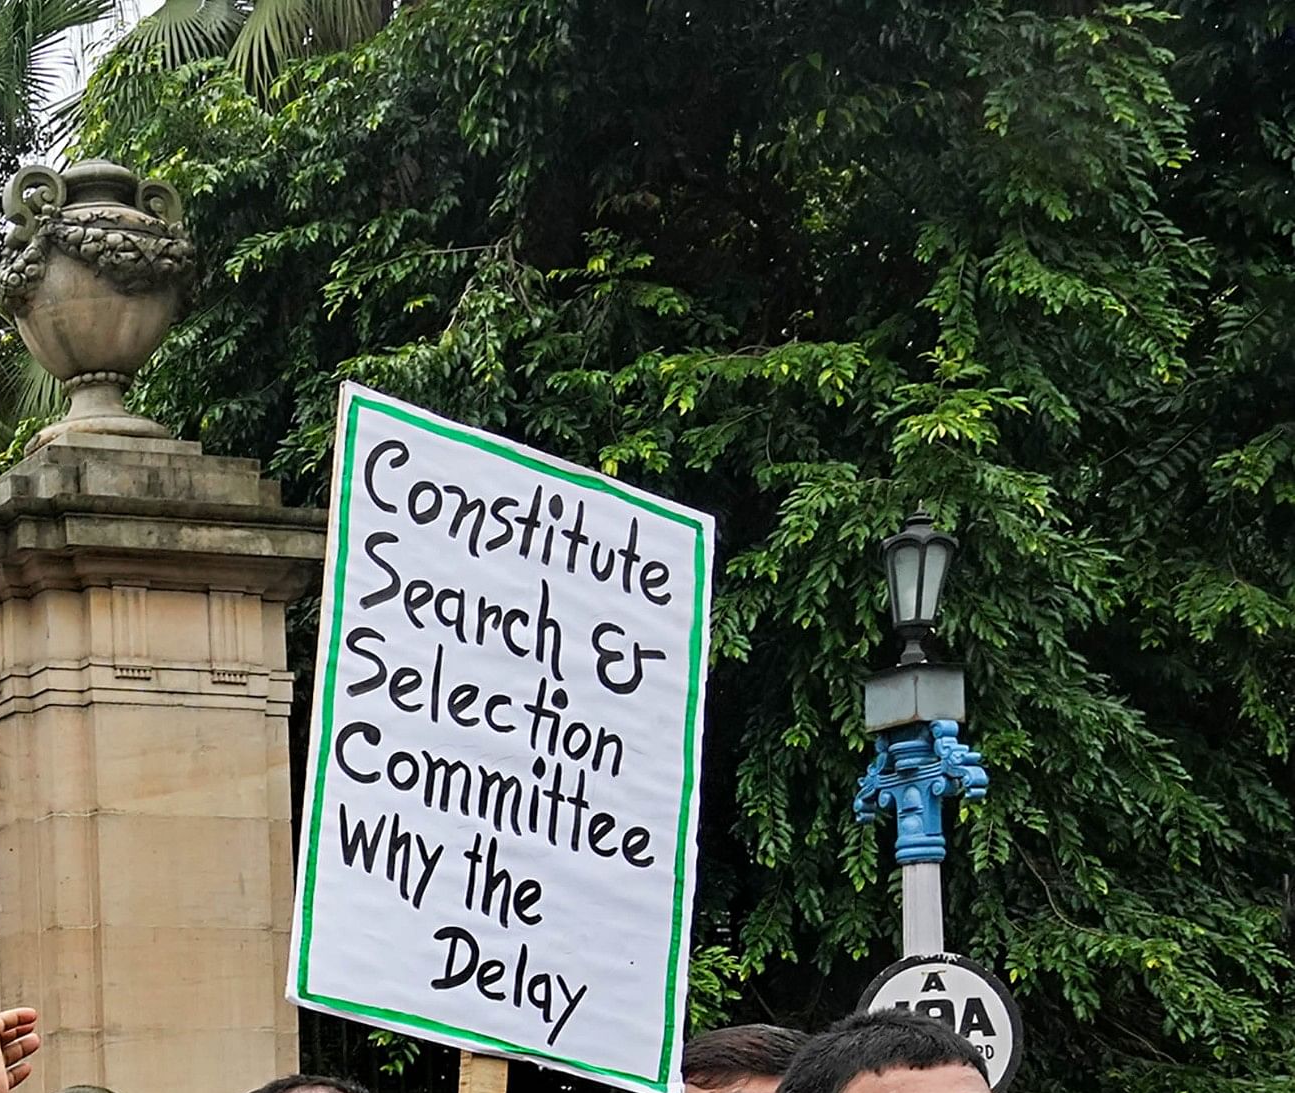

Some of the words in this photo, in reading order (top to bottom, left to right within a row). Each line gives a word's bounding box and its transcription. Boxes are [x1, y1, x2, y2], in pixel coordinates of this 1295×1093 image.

[364, 439, 672, 606] Constitute
[360, 532, 565, 682] Search
[346, 627, 623, 779] Selection
[336, 721, 655, 868] Committee
[464, 832, 544, 929] the
[431, 926, 588, 1046] Delay
